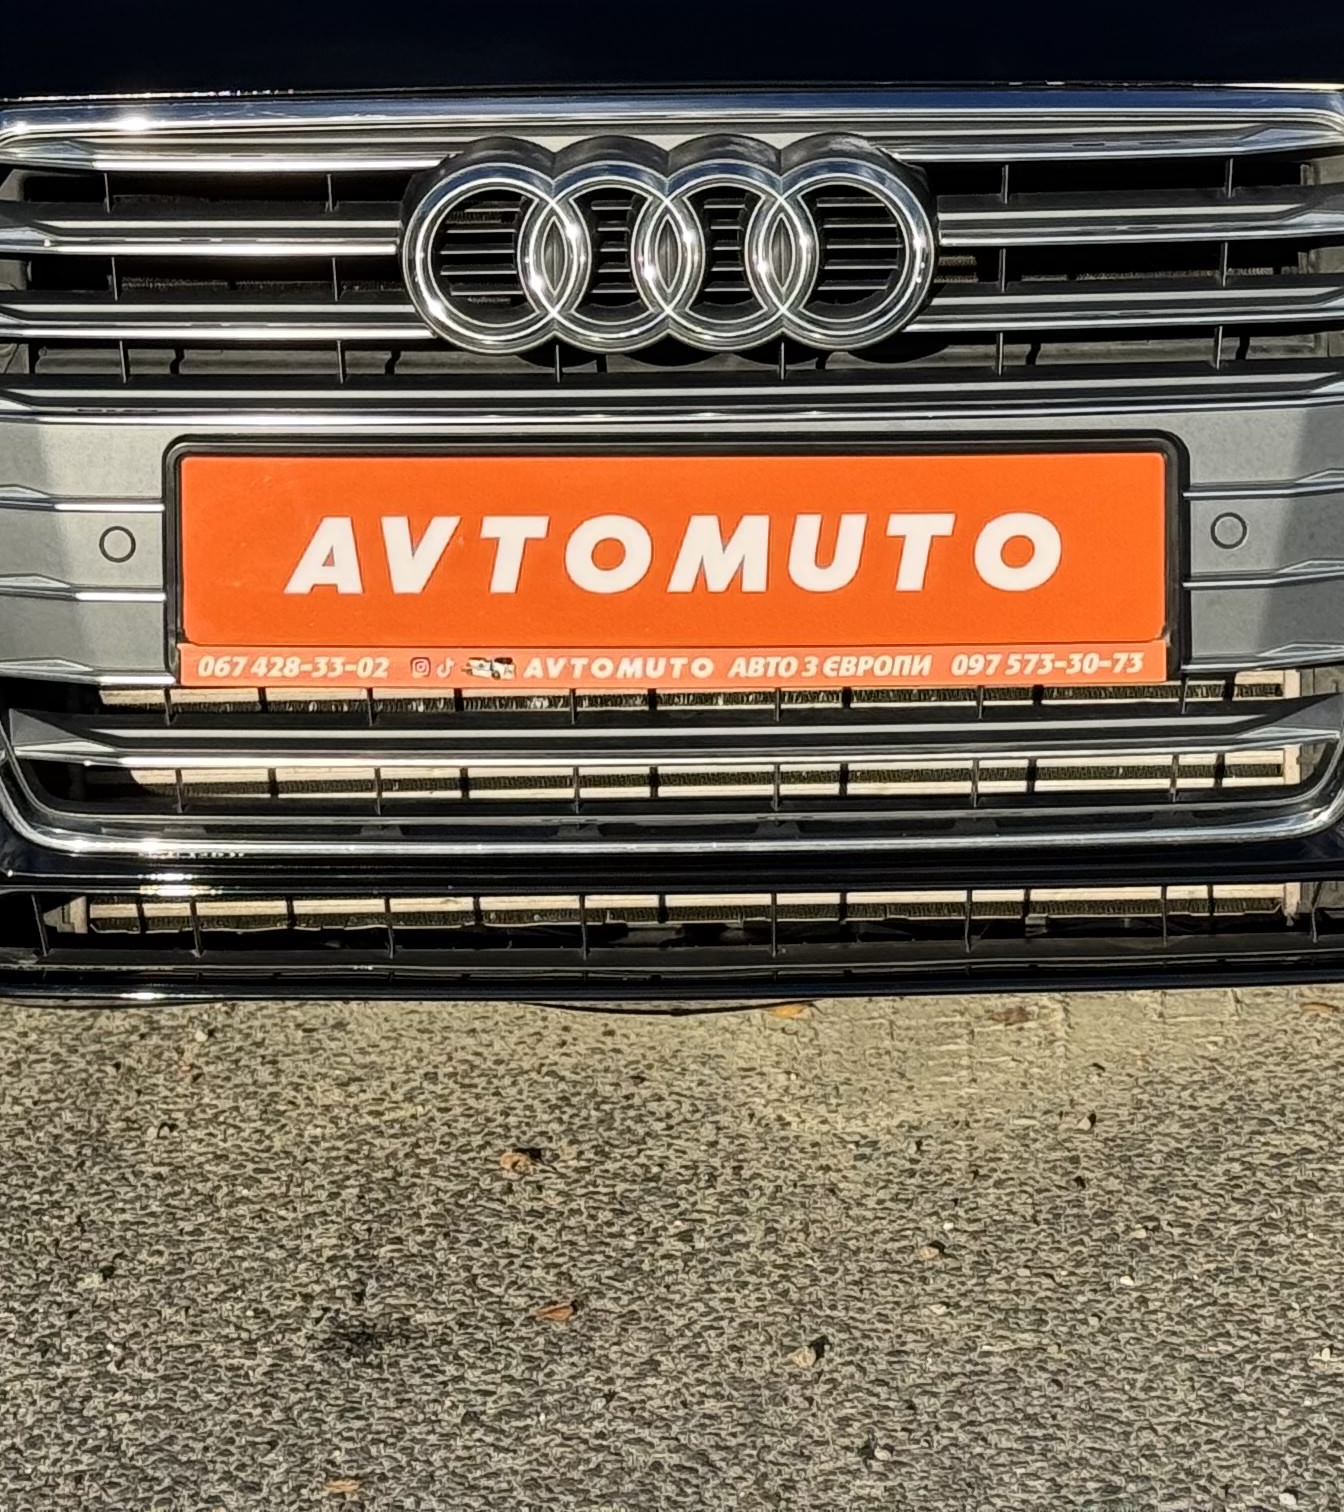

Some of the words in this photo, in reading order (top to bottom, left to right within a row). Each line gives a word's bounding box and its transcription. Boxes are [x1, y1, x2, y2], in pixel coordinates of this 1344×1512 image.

[283, 512, 1064, 595] AVTOMUTO
[197, 655, 247, 678] 067
[250, 655, 390, 679] 428-33-02
[522, 656, 715, 679] AVTOMUTO
[727, 655, 798, 678] АВТО
[822, 654, 934, 678] ЄВРОПИ
[950, 653, 1003, 676] 097
[1005, 651, 1145, 675] 573-30-73
